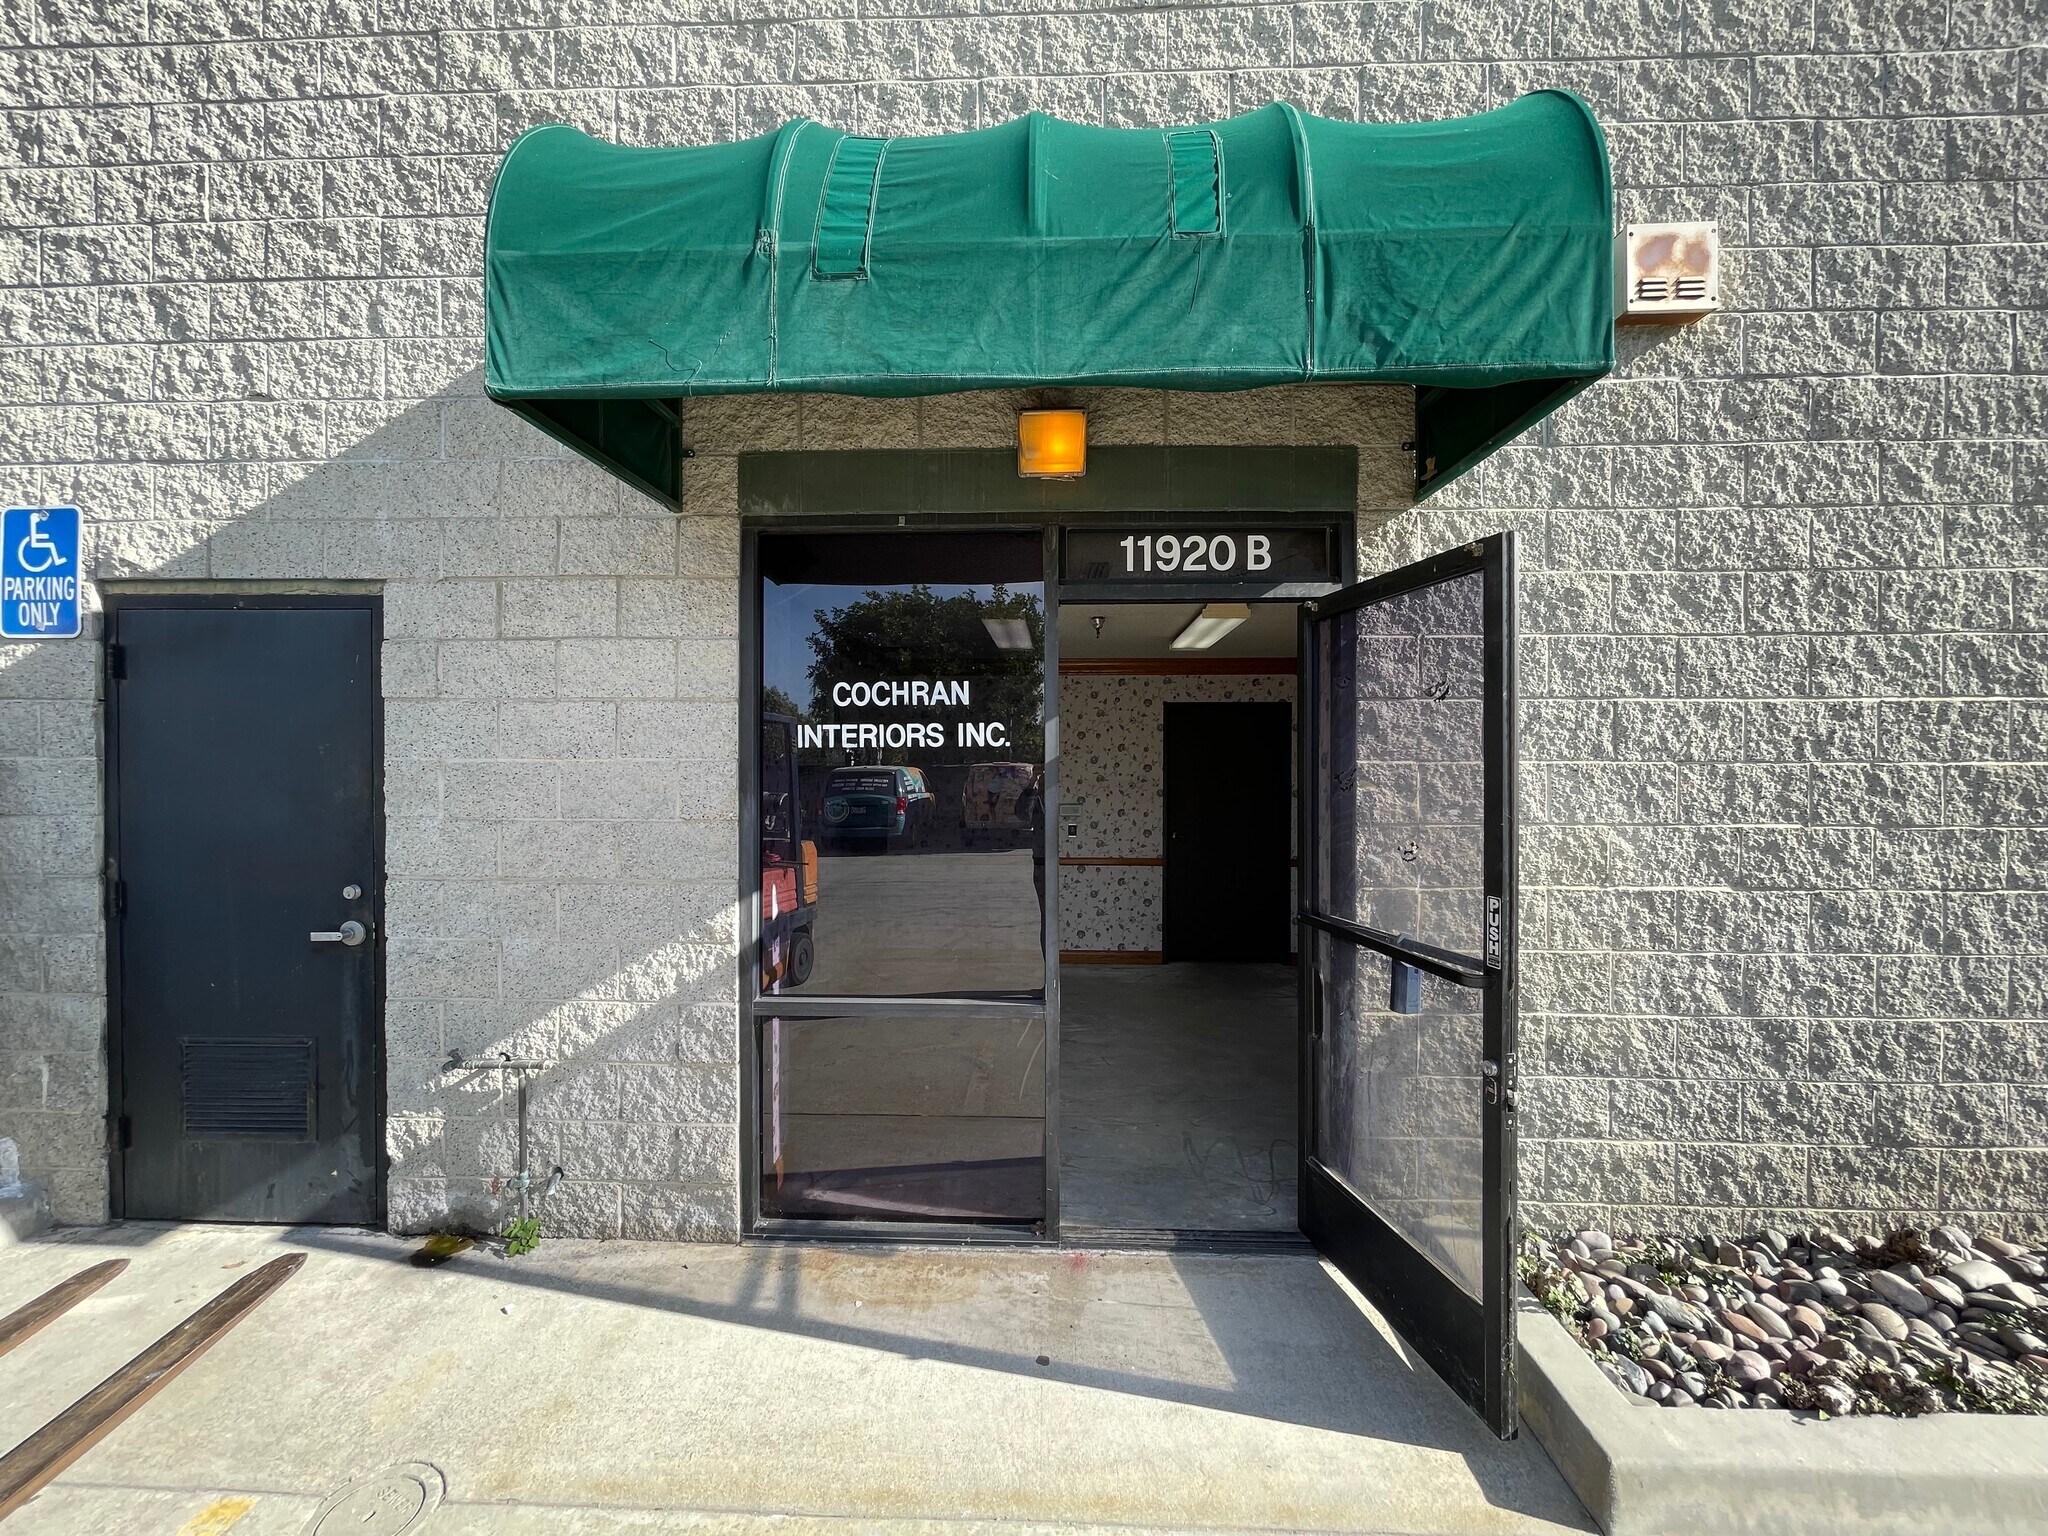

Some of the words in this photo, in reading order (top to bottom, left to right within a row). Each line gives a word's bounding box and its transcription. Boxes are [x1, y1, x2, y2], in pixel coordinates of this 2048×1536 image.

[1121, 535, 1236, 571] 11920
[1248, 535, 1272, 571] B
[4, 576, 75, 600] PARKING
[18, 602, 60, 626] ONLY
[832, 681, 969, 707] COCHRAN
[797, 723, 944, 748] INTERIORS
[958, 722, 1011, 748] INC.
[1489, 898, 1499, 956] PUSH
